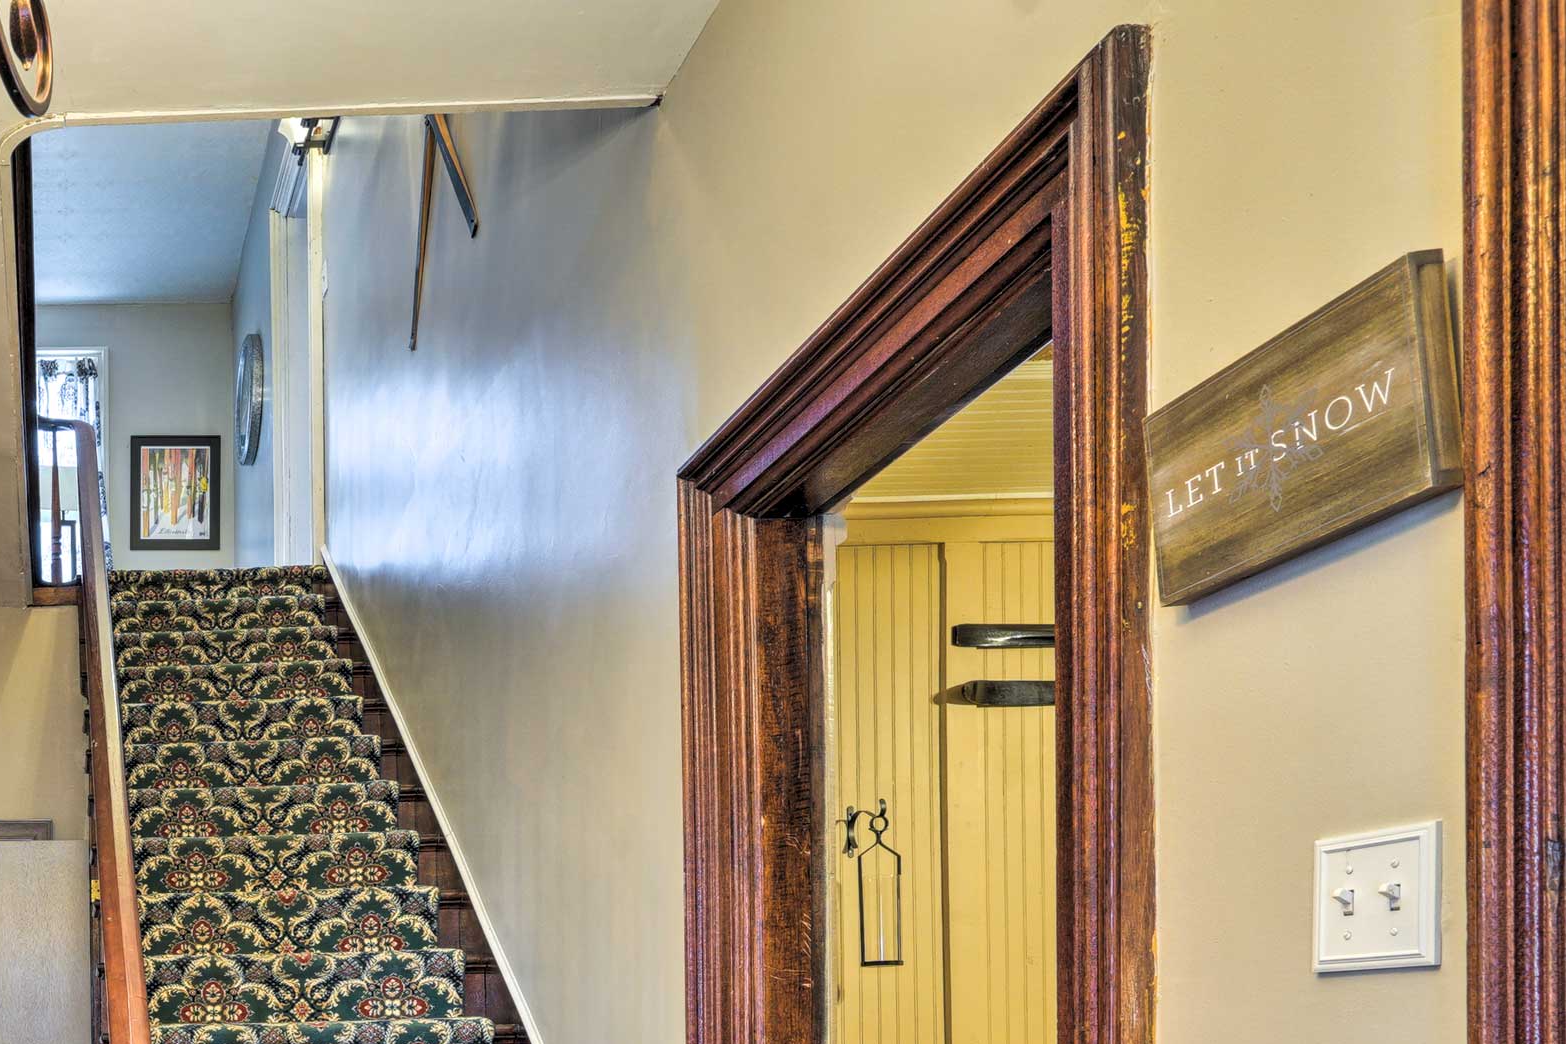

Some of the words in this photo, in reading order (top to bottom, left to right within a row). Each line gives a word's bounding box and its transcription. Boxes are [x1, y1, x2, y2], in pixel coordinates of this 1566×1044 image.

[1165, 461, 1225, 518] LET
[1234, 448, 1259, 477] IT
[1271, 367, 1395, 462] SNOW
